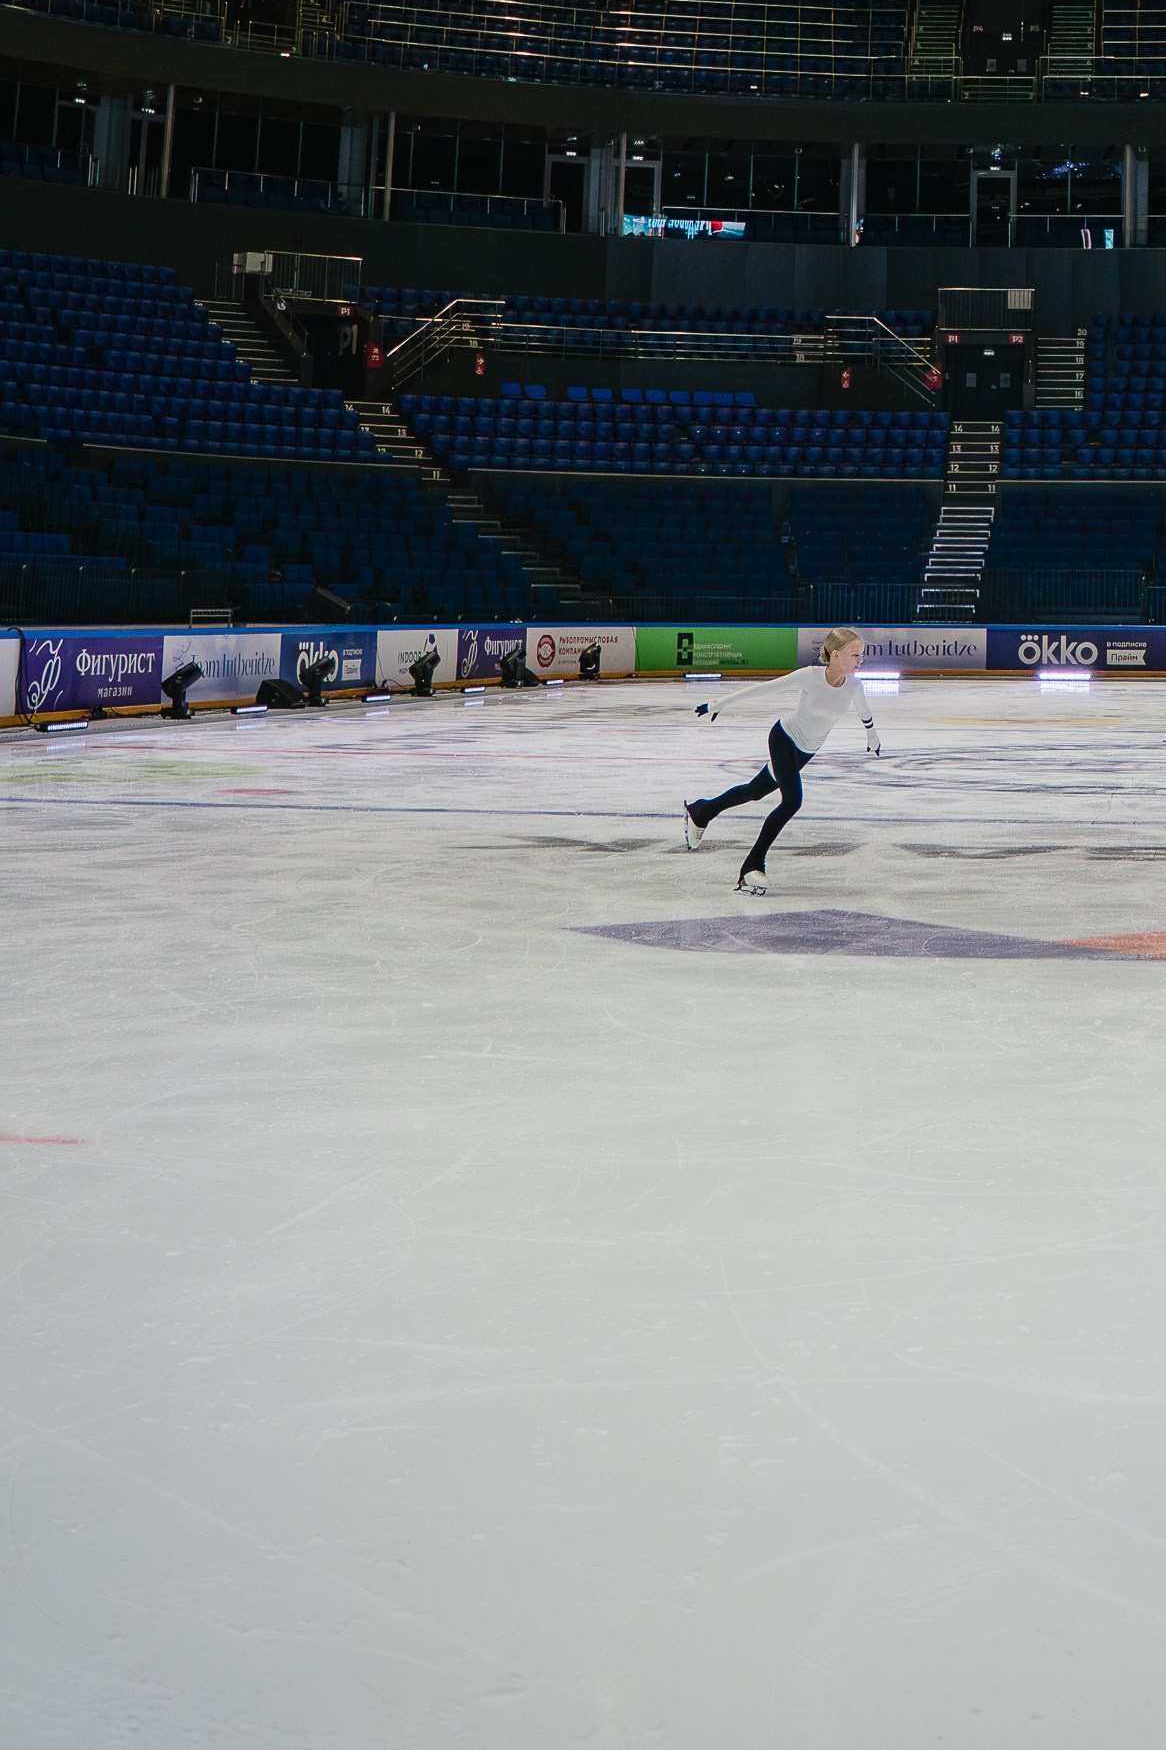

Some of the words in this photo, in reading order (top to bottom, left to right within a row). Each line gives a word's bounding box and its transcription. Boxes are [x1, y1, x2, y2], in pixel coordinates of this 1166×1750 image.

[340, 307, 351, 315] P1
[1077, 328, 1087, 336] 20
[948, 335, 958, 343] P1
[1012, 335, 1023, 343] P2
[1075, 372, 1085, 380] 17
[382, 406, 391, 415] 14
[954, 425, 963, 433] 14
[991, 425, 1000, 433] 14
[952, 445, 962, 453] 13
[990, 445, 999, 453] 13
[414, 449, 424, 458] 12
[950, 464, 960, 472] 12
[988, 464, 998, 472] 12
[432, 470, 441, 479] 11
[948, 484, 957, 492] 11
[988, 484, 996, 492] 11
[889, 639, 977, 657] Tutberidze
[1112, 652, 1138, 662] Прайм
[76, 648, 156, 683] Фигурист
[97, 686, 133, 699] магазин
